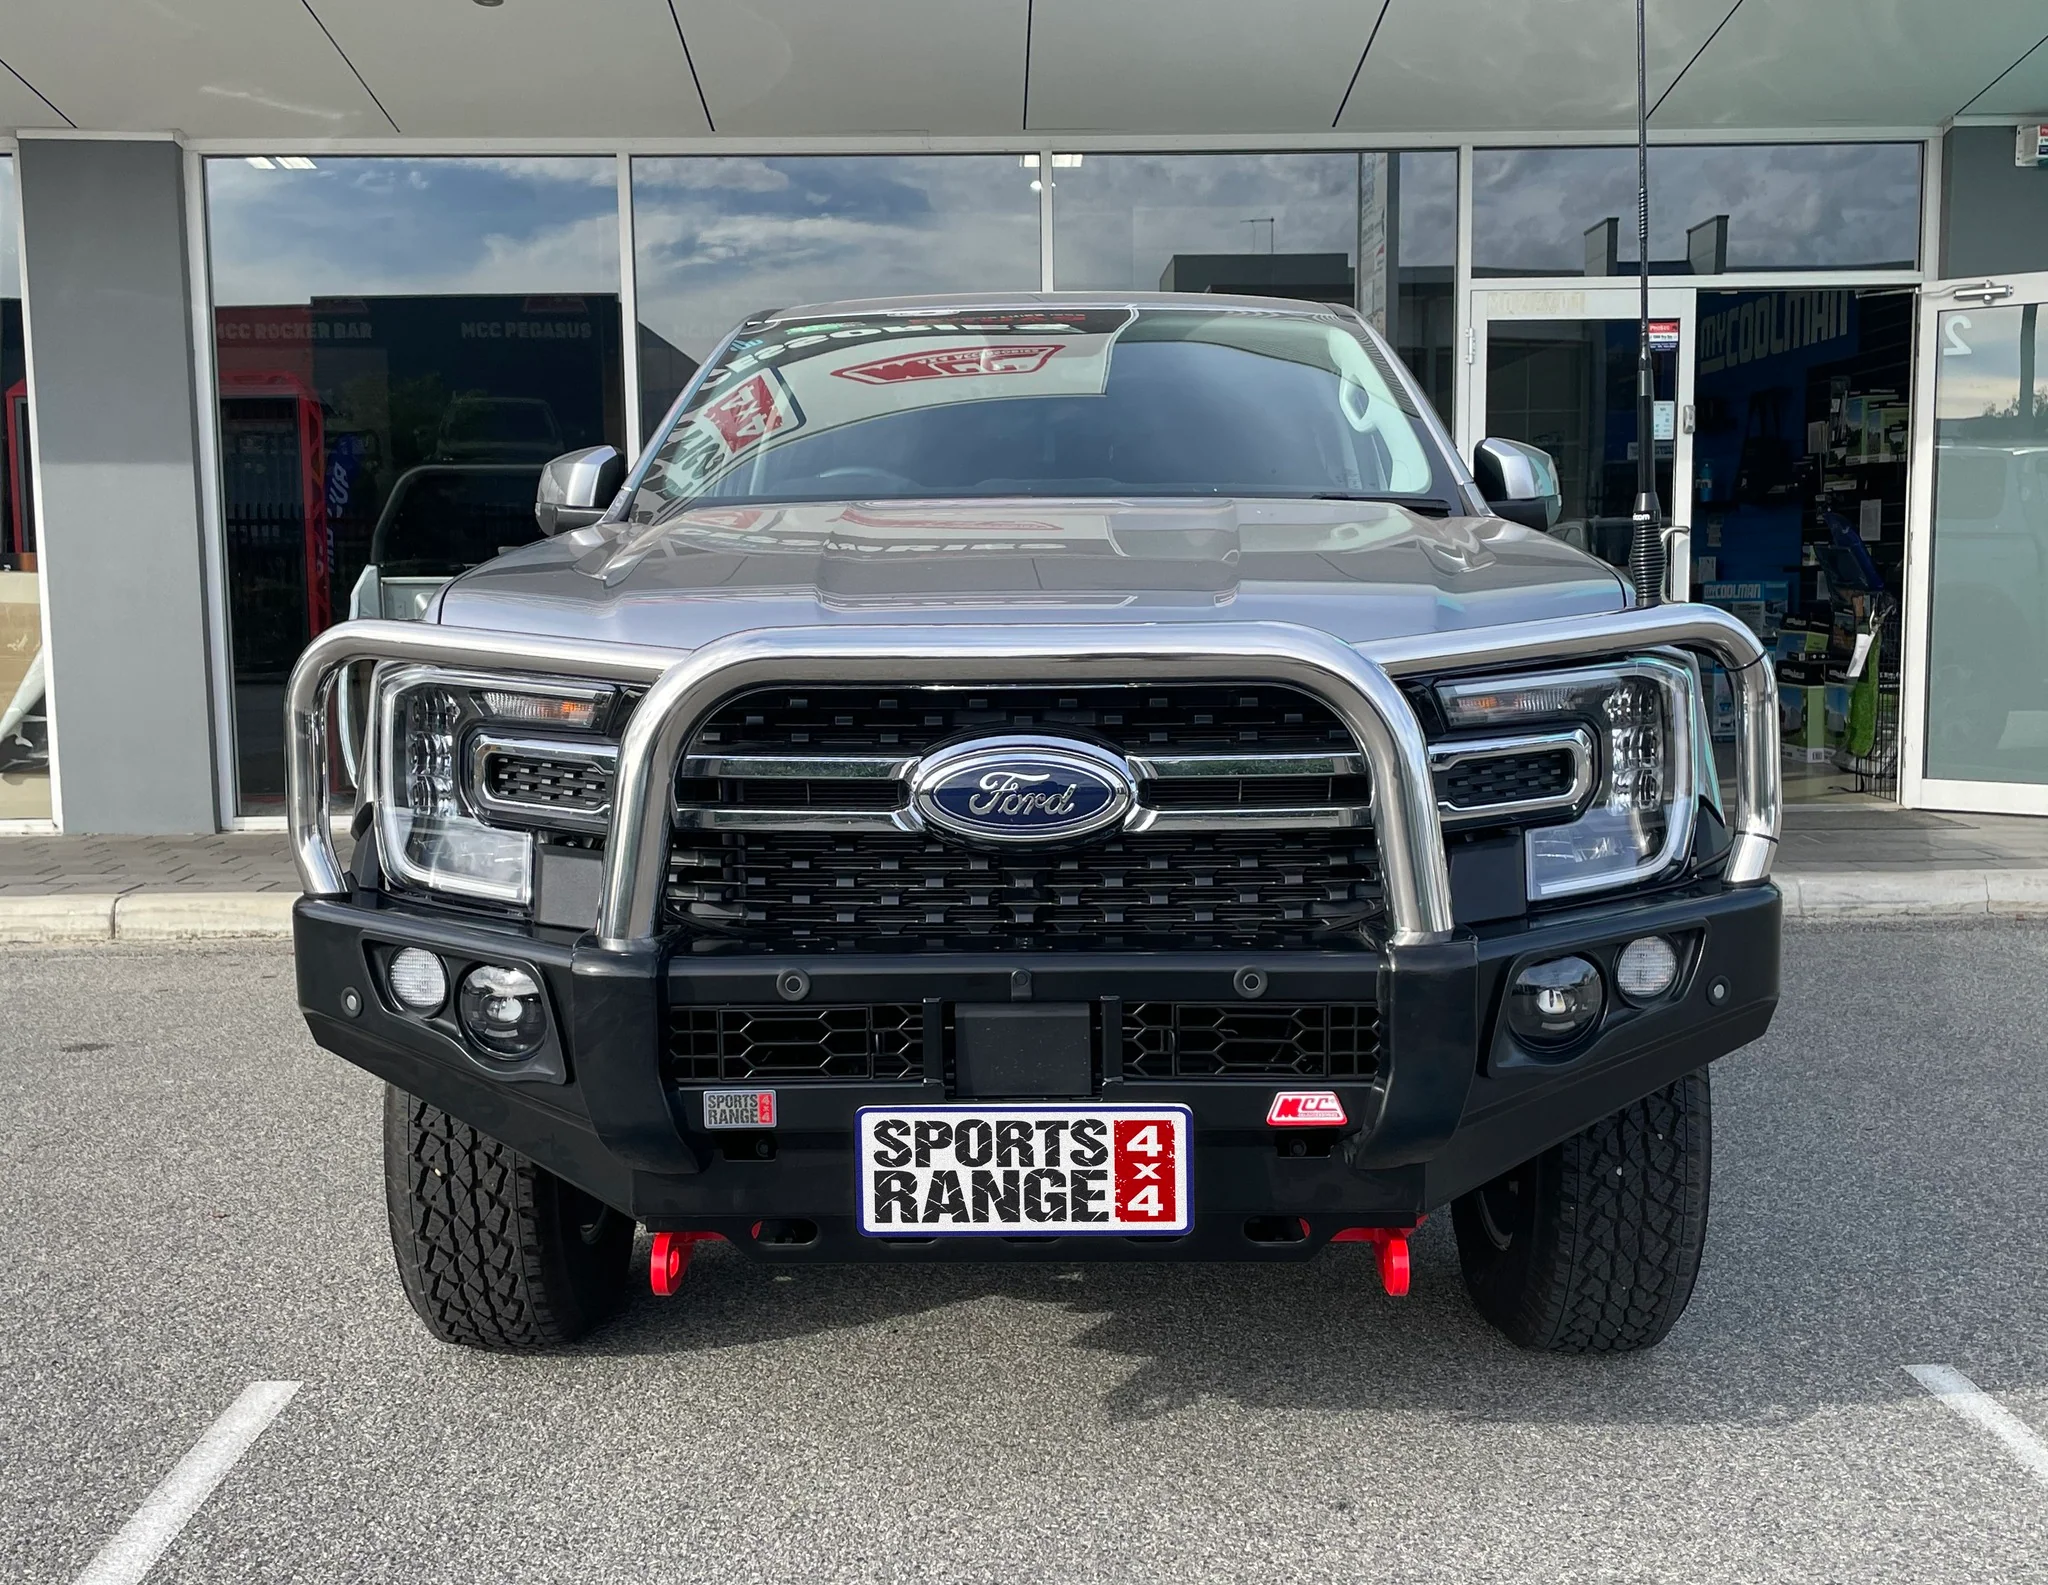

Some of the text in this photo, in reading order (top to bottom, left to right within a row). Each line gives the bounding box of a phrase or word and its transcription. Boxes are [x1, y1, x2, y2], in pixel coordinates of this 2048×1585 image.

[254, 322, 330, 339] ROCKER
[333, 322, 372, 339] BAR
[461, 322, 592, 338] MCC PEGASUS
[969, 771, 1077, 815] Ford
[708, 1095, 758, 1108] SPORTS
[1276, 1098, 1337, 1117] MCC
[708, 1109, 758, 1124] RANGE
[873, 1119, 1109, 1168] SPORTS
[873, 1168, 1110, 1224] RANGE
